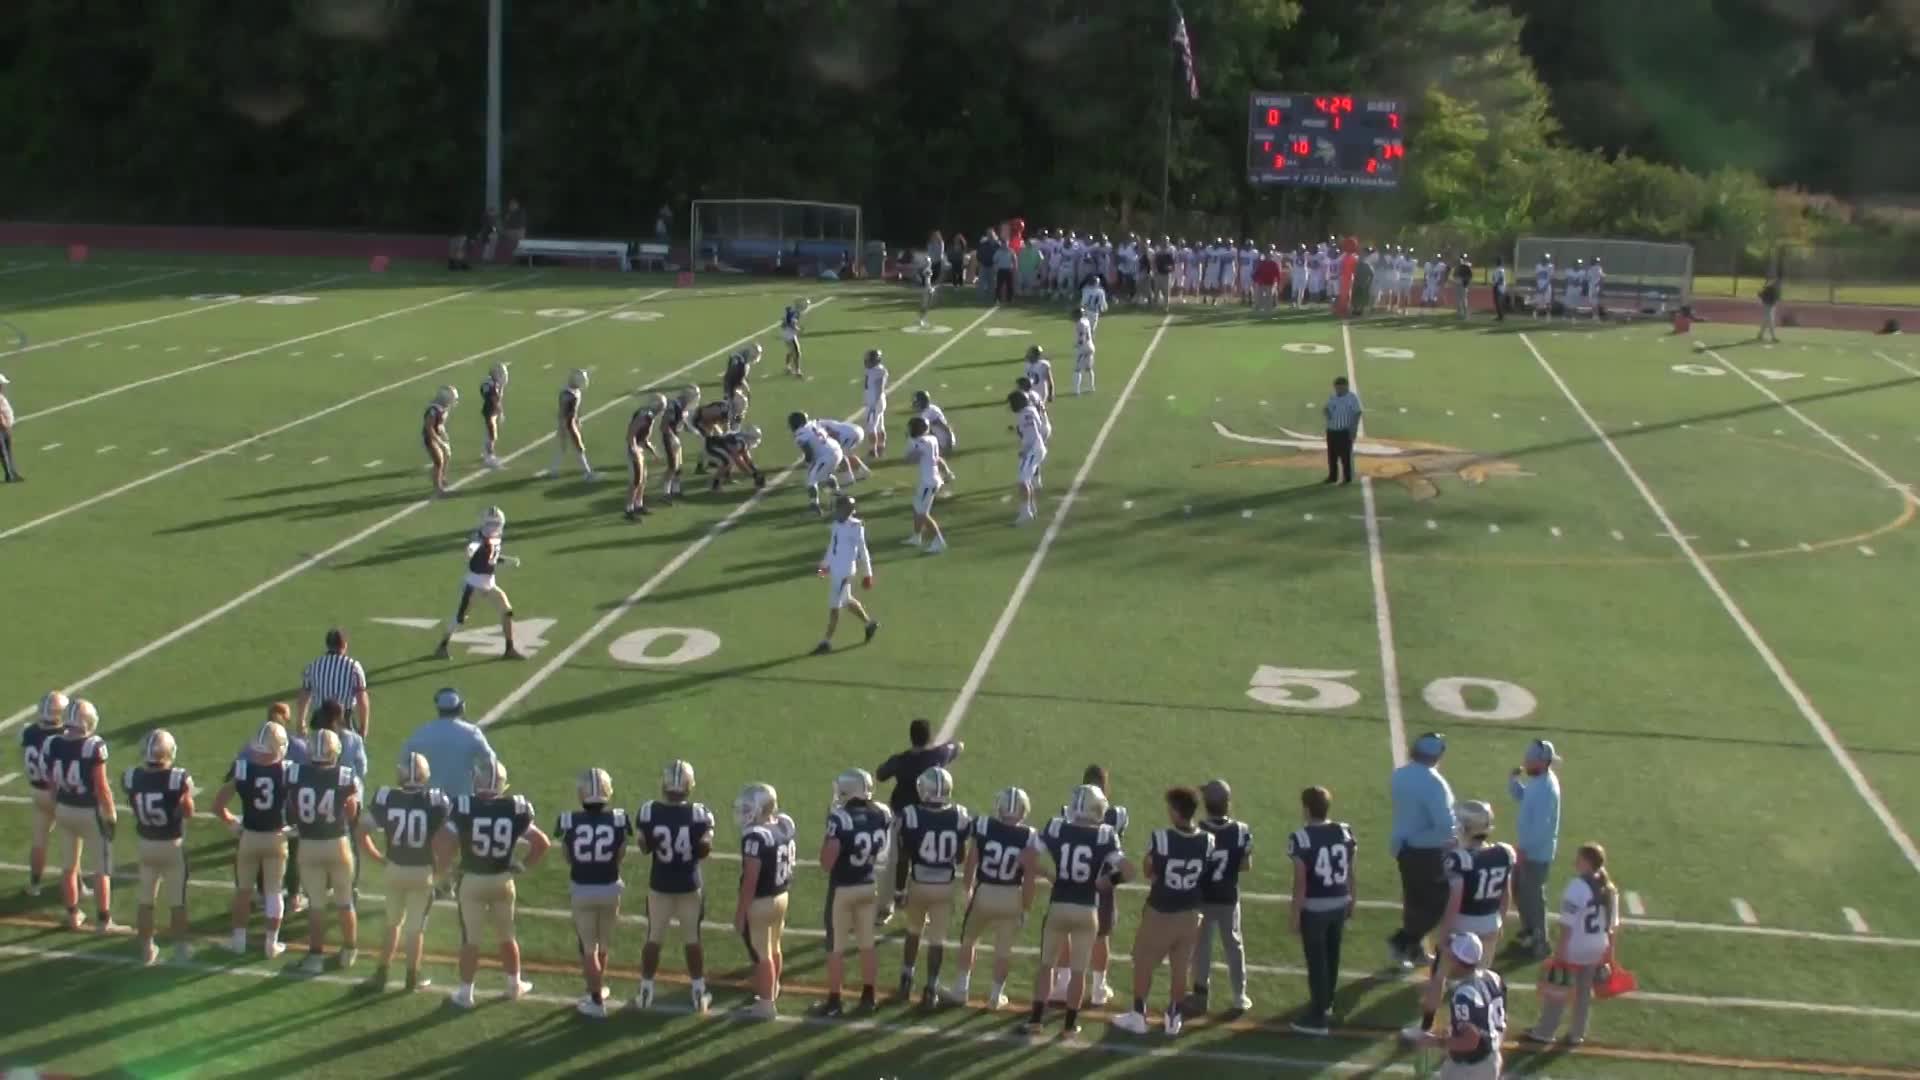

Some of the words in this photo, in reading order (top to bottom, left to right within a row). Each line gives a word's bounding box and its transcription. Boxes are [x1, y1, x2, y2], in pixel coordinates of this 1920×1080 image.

[1266, 109, 1281, 126] 0
[1314, 96, 1354, 113] 4:29
[1388, 112, 1400, 128] 7
[1272, 154, 1286, 168] 3
[1292, 140, 1311, 155] 10
[1366, 157, 1378, 172] 2
[136, 791, 167, 826] 15
[254, 777, 275, 811] 3
[298, 789, 337, 824] 84
[387, 809, 427, 848] 70
[472, 817, 513, 857] 59
[574, 824, 613, 862] 22
[653, 825, 693, 863] 34
[919, 831, 957, 864] 40
[982, 841, 1020, 880] 20
[1060, 842, 1092, 883] 16
[1315, 844, 1348, 886] 43
[1474, 866, 1507, 900] 12
